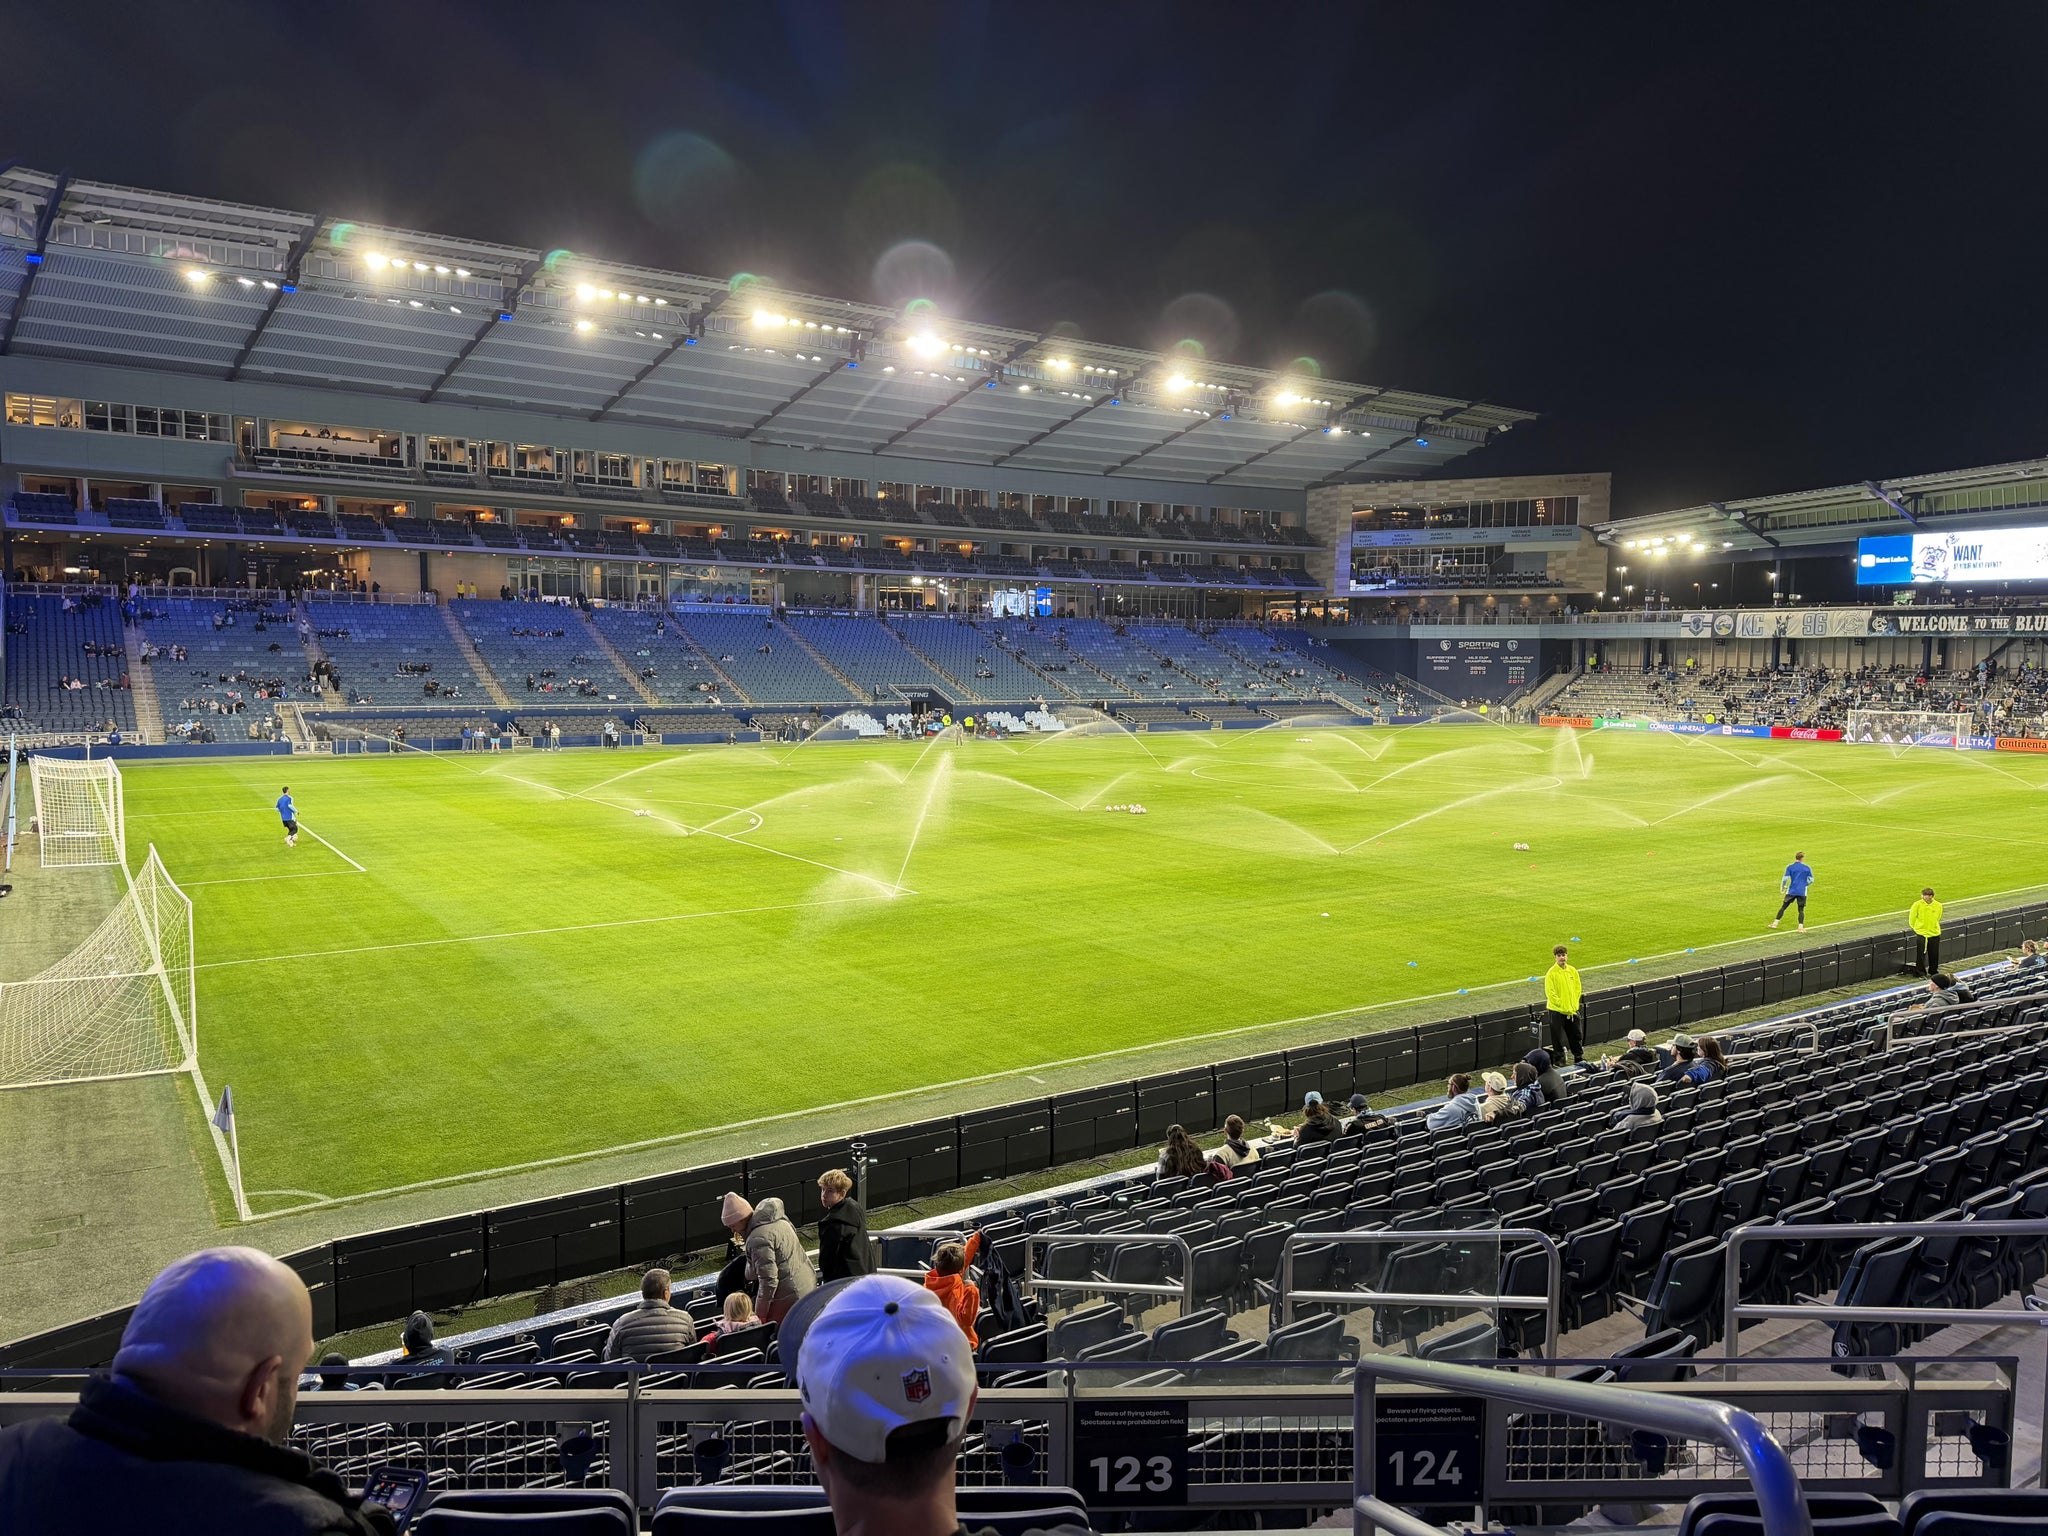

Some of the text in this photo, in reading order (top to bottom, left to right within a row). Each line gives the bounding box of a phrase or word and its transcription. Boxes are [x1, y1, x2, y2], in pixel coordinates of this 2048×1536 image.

[1953, 544, 1983, 561] WANT
[1742, 614, 1764, 635] KC
[1802, 613, 1828, 635] 96
[1899, 616, 1968, 631] WELCOME
[1975, 619, 1986, 629] TO
[1990, 618, 2008, 629] THE
[1959, 738, 1992, 746] ULTRA
[908, 1382, 928, 1400] NFL
[1090, 1456, 1172, 1492] 123
[1389, 1450, 1462, 1486] 124
